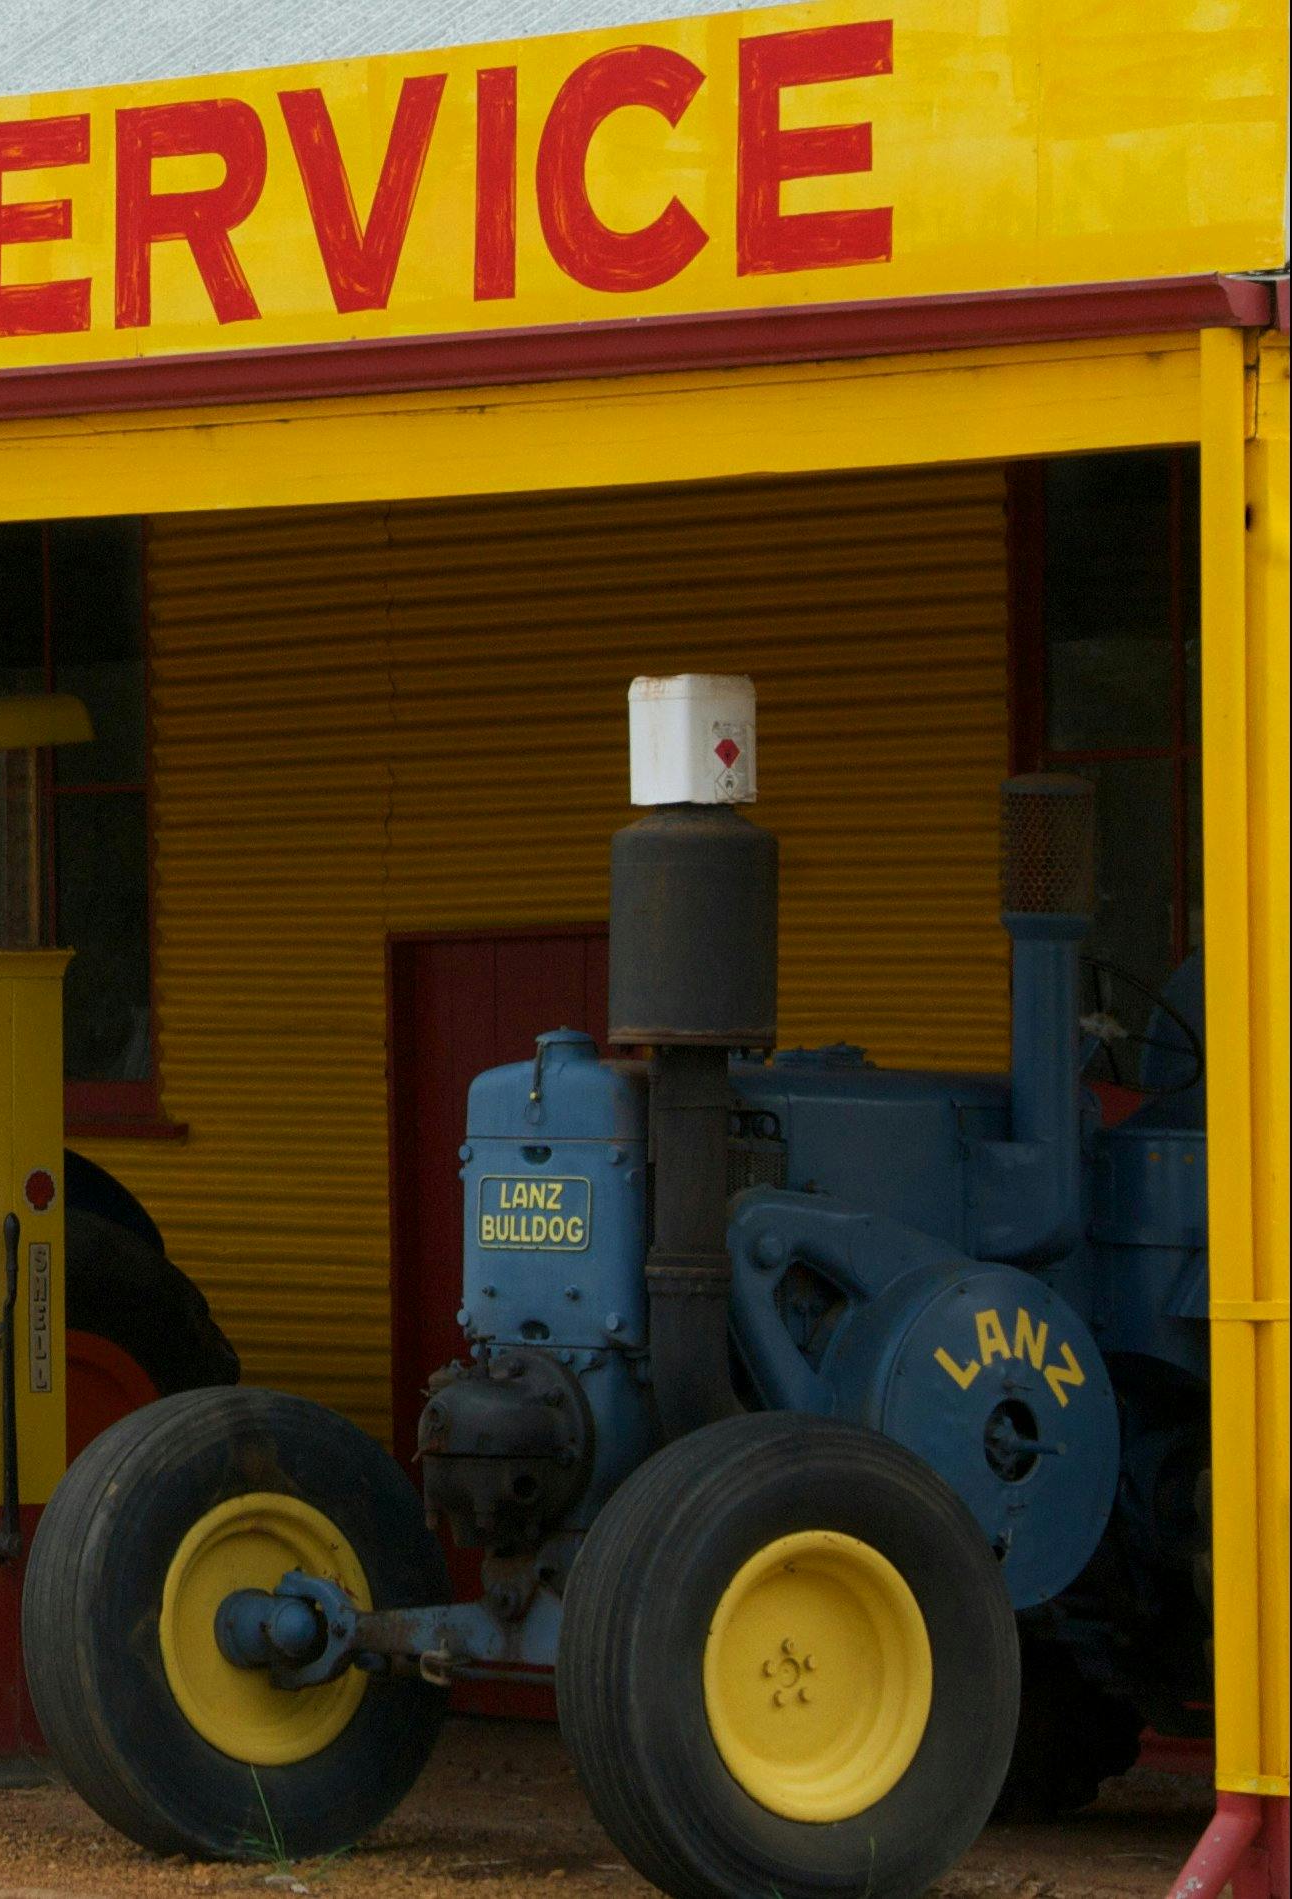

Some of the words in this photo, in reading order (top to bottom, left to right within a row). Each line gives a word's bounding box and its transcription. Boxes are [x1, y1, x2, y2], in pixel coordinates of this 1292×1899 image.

[499, 1183, 564, 1210] LANZ
[482, 1215, 585, 1243] BULLDOG
[33, 1248, 47, 1389] SHELL
[934, 1308, 1086, 1407] LANZ
